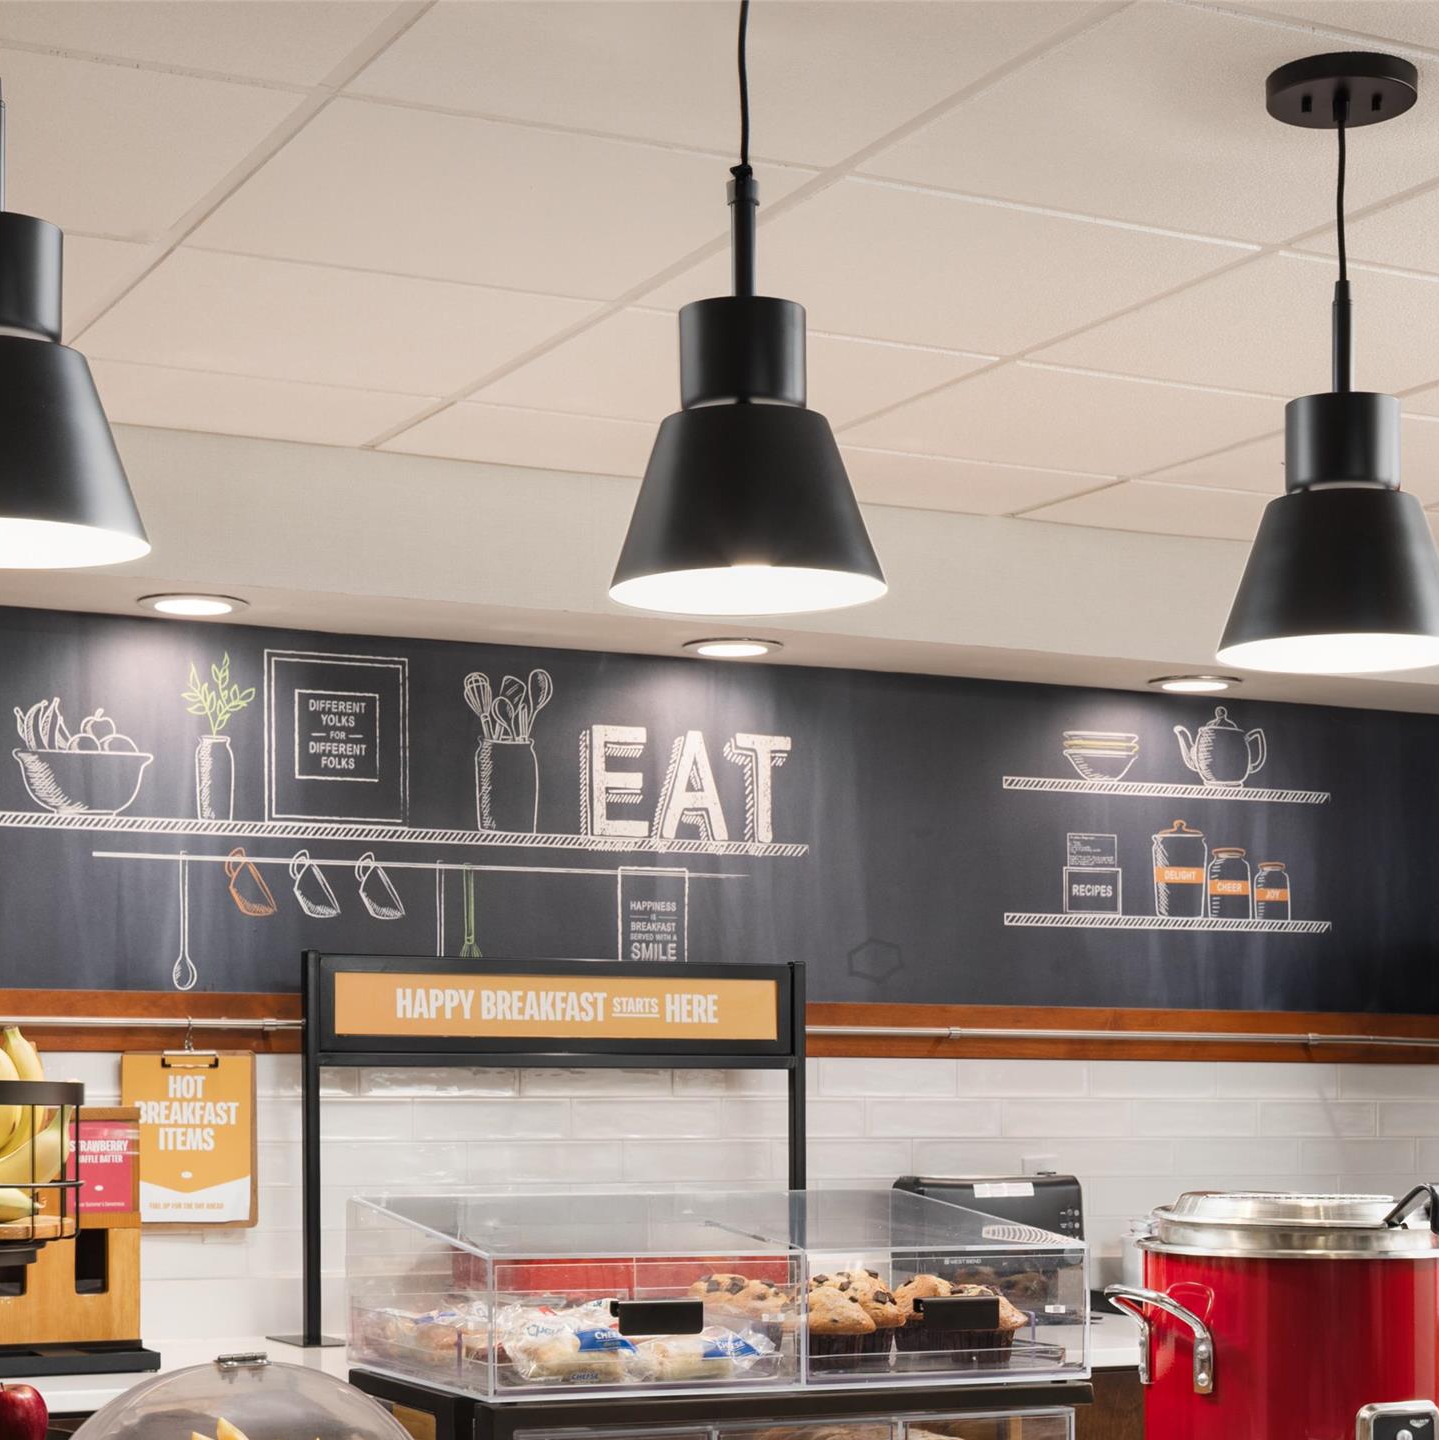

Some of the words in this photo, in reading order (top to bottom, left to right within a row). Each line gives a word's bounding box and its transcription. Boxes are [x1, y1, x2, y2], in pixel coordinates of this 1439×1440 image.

[309, 699, 367, 714] DIFFERENT
[321, 714, 356, 727] YOLKS
[329, 731, 346, 740] FOR
[309, 741, 367, 756] DIFFERENT
[321, 756, 356, 769] FOLKS
[579, 724, 792, 850] EAT
[1164, 870, 1198, 881] DELIGHT
[1072, 884, 1113, 897] RECIPES
[1216, 882, 1242, 892] CHEER
[1265, 890, 1280, 899] JOY
[629, 901, 677, 912] HAPPINESS
[630, 921, 676, 932] BREAKFAST
[629, 933, 654, 941] SERVED
[655, 933, 671, 941] WITH
[672, 934, 678, 942] A
[631, 942, 677, 961] SMILE
[396, 988, 475, 1019] HAPPY
[480, 990, 607, 1022] BREAKFAST
[612, 997, 658, 1014] STARTS
[665, 994, 719, 1024] HERE
[168, 1075, 206, 1098] HOT
[135, 1101, 239, 1125] BREAKFAST
[158, 1127, 215, 1151] ITEMS
[99, 1154, 123, 1164] BATTER
